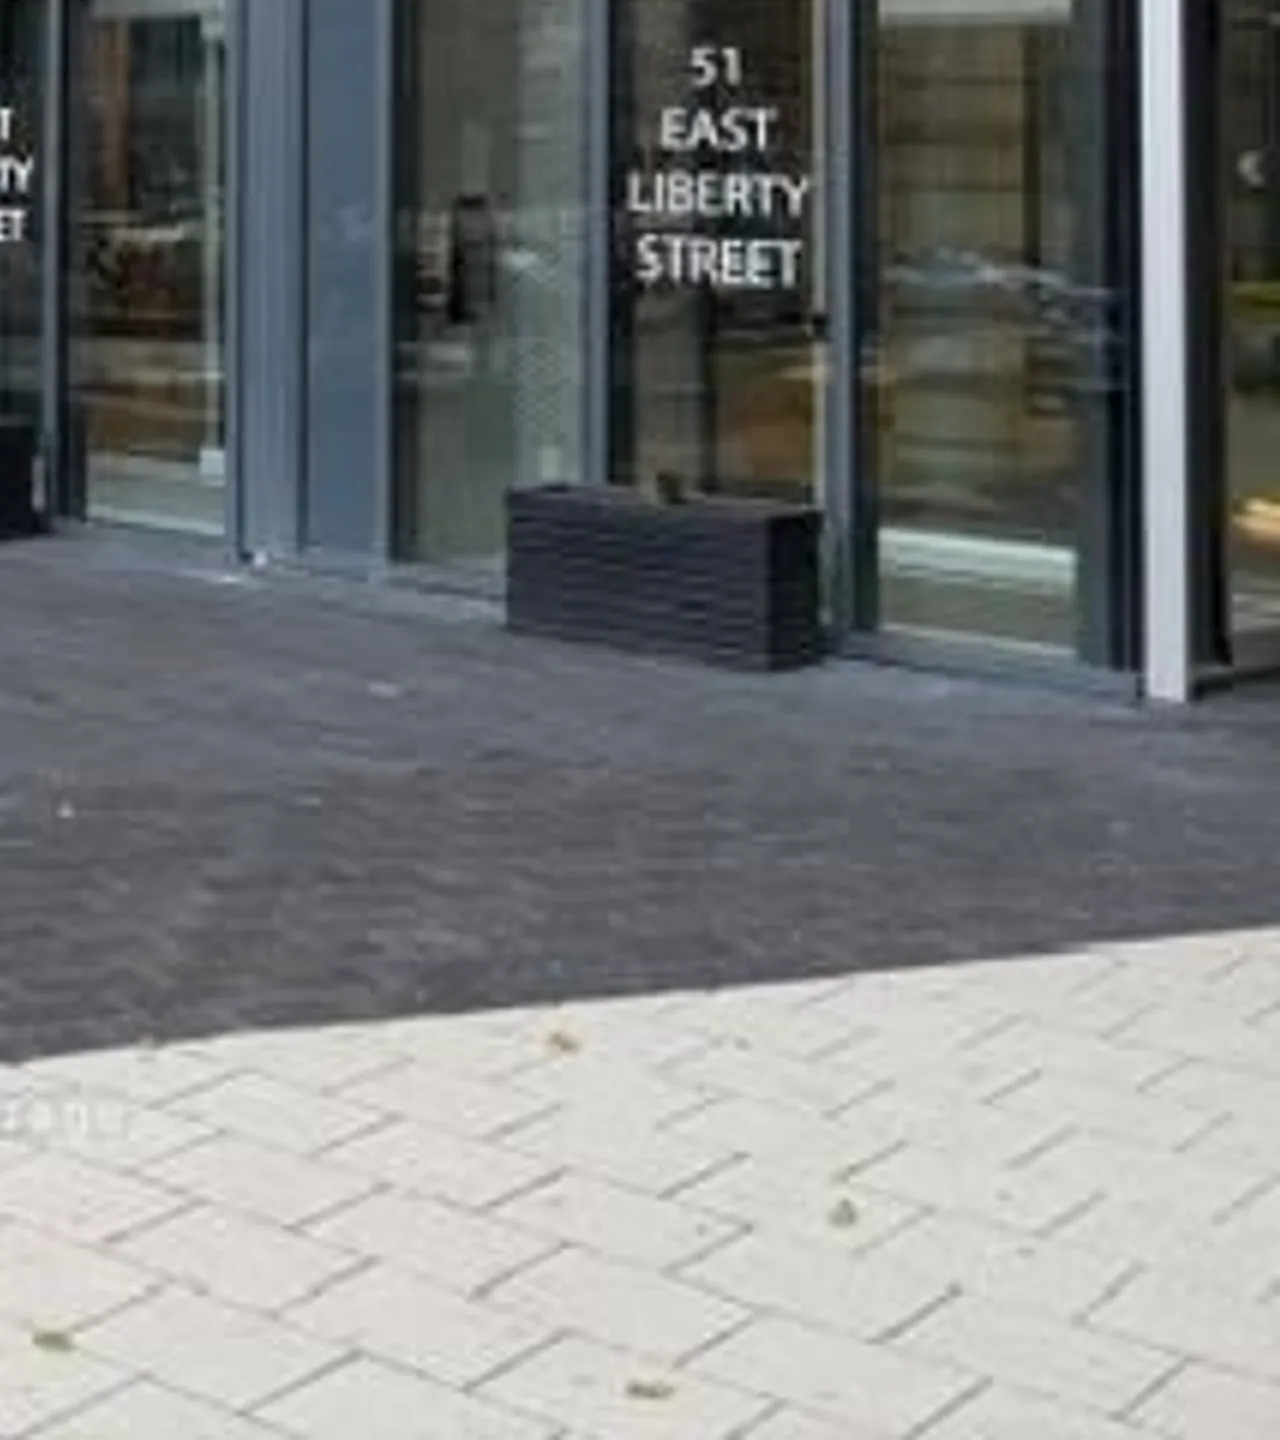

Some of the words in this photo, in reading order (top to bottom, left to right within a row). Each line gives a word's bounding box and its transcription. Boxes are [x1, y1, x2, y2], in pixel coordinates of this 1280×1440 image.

[689, 46, 740, 87] 51
[659, 105, 781, 152] EAST
[626, 166, 811, 219] LIBERTY
[635, 232, 805, 291] STREET
